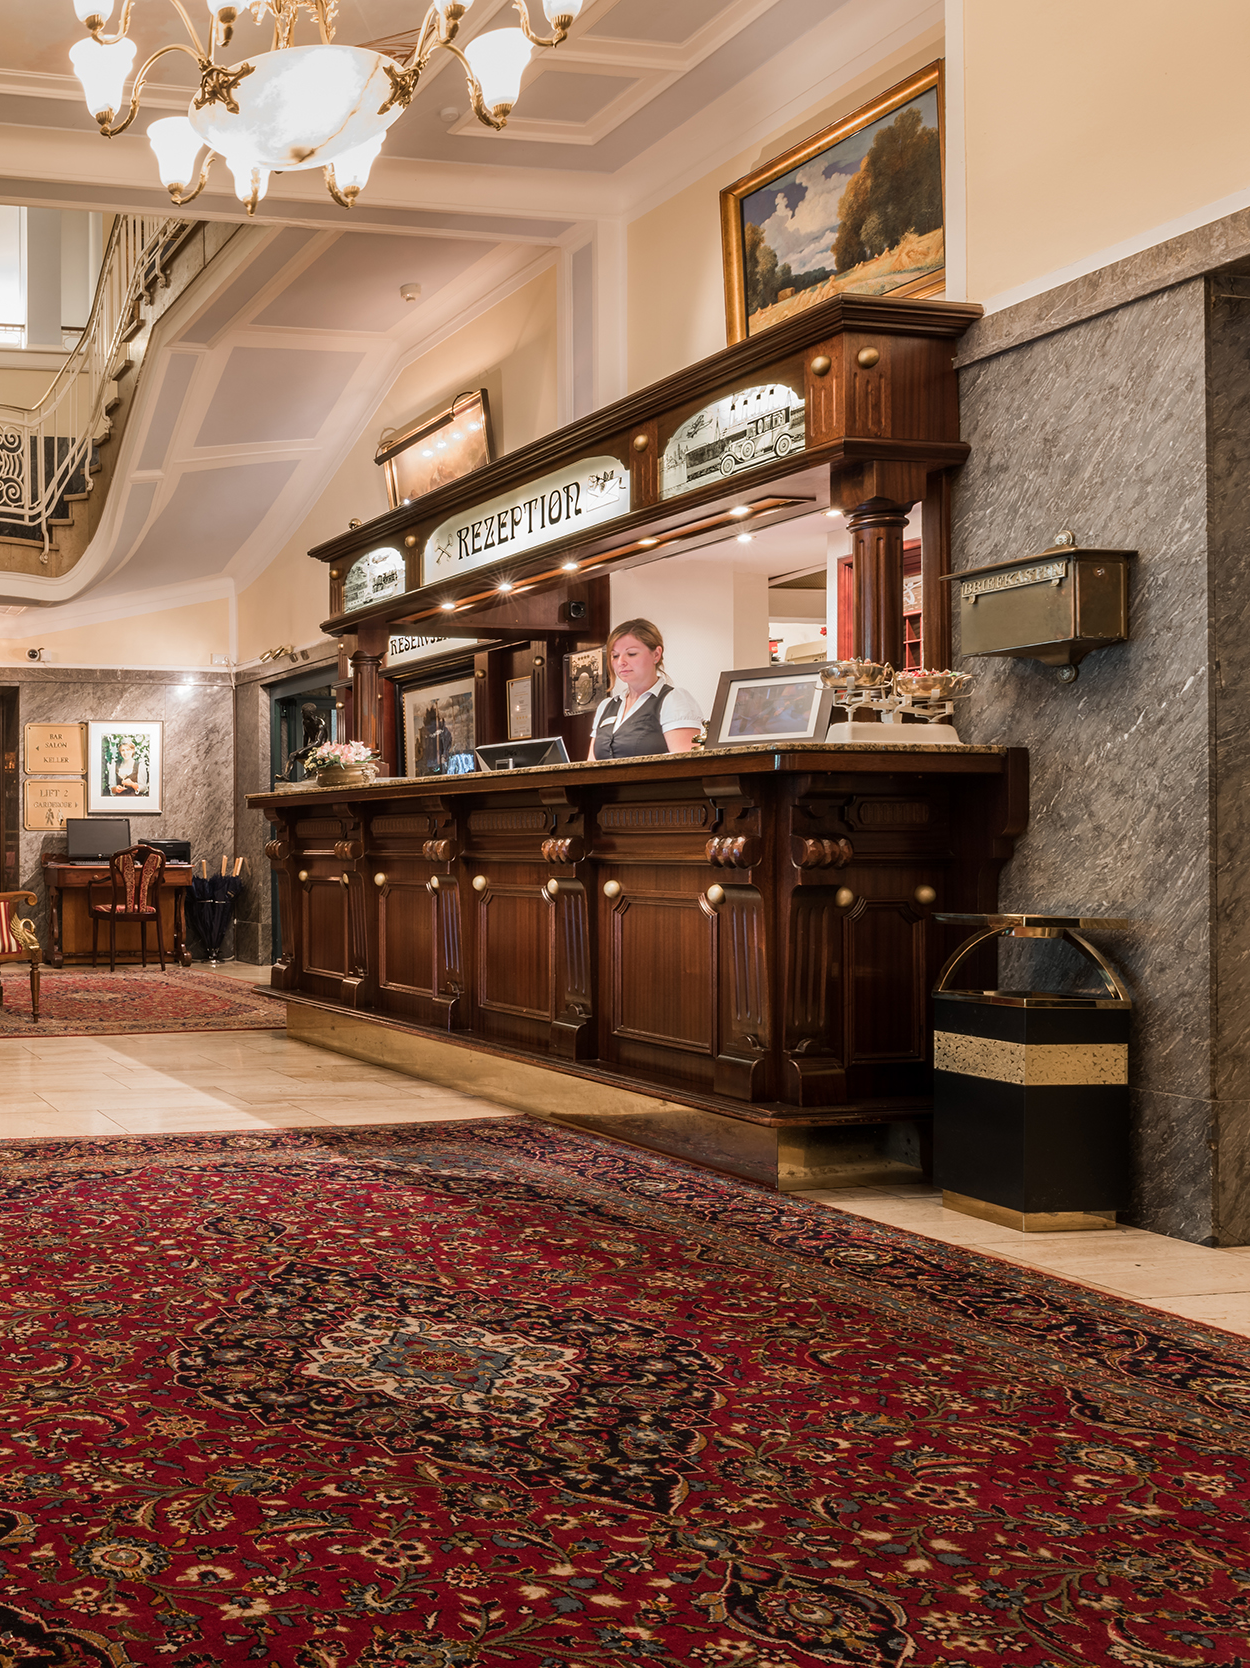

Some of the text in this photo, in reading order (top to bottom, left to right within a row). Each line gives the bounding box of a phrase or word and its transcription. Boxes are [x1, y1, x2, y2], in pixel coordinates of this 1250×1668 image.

[456, 481, 582, 560] REZEPTION
[964, 562, 1064, 595] BRIEFKASTEN
[39, 789, 69, 798] LIFT 2
